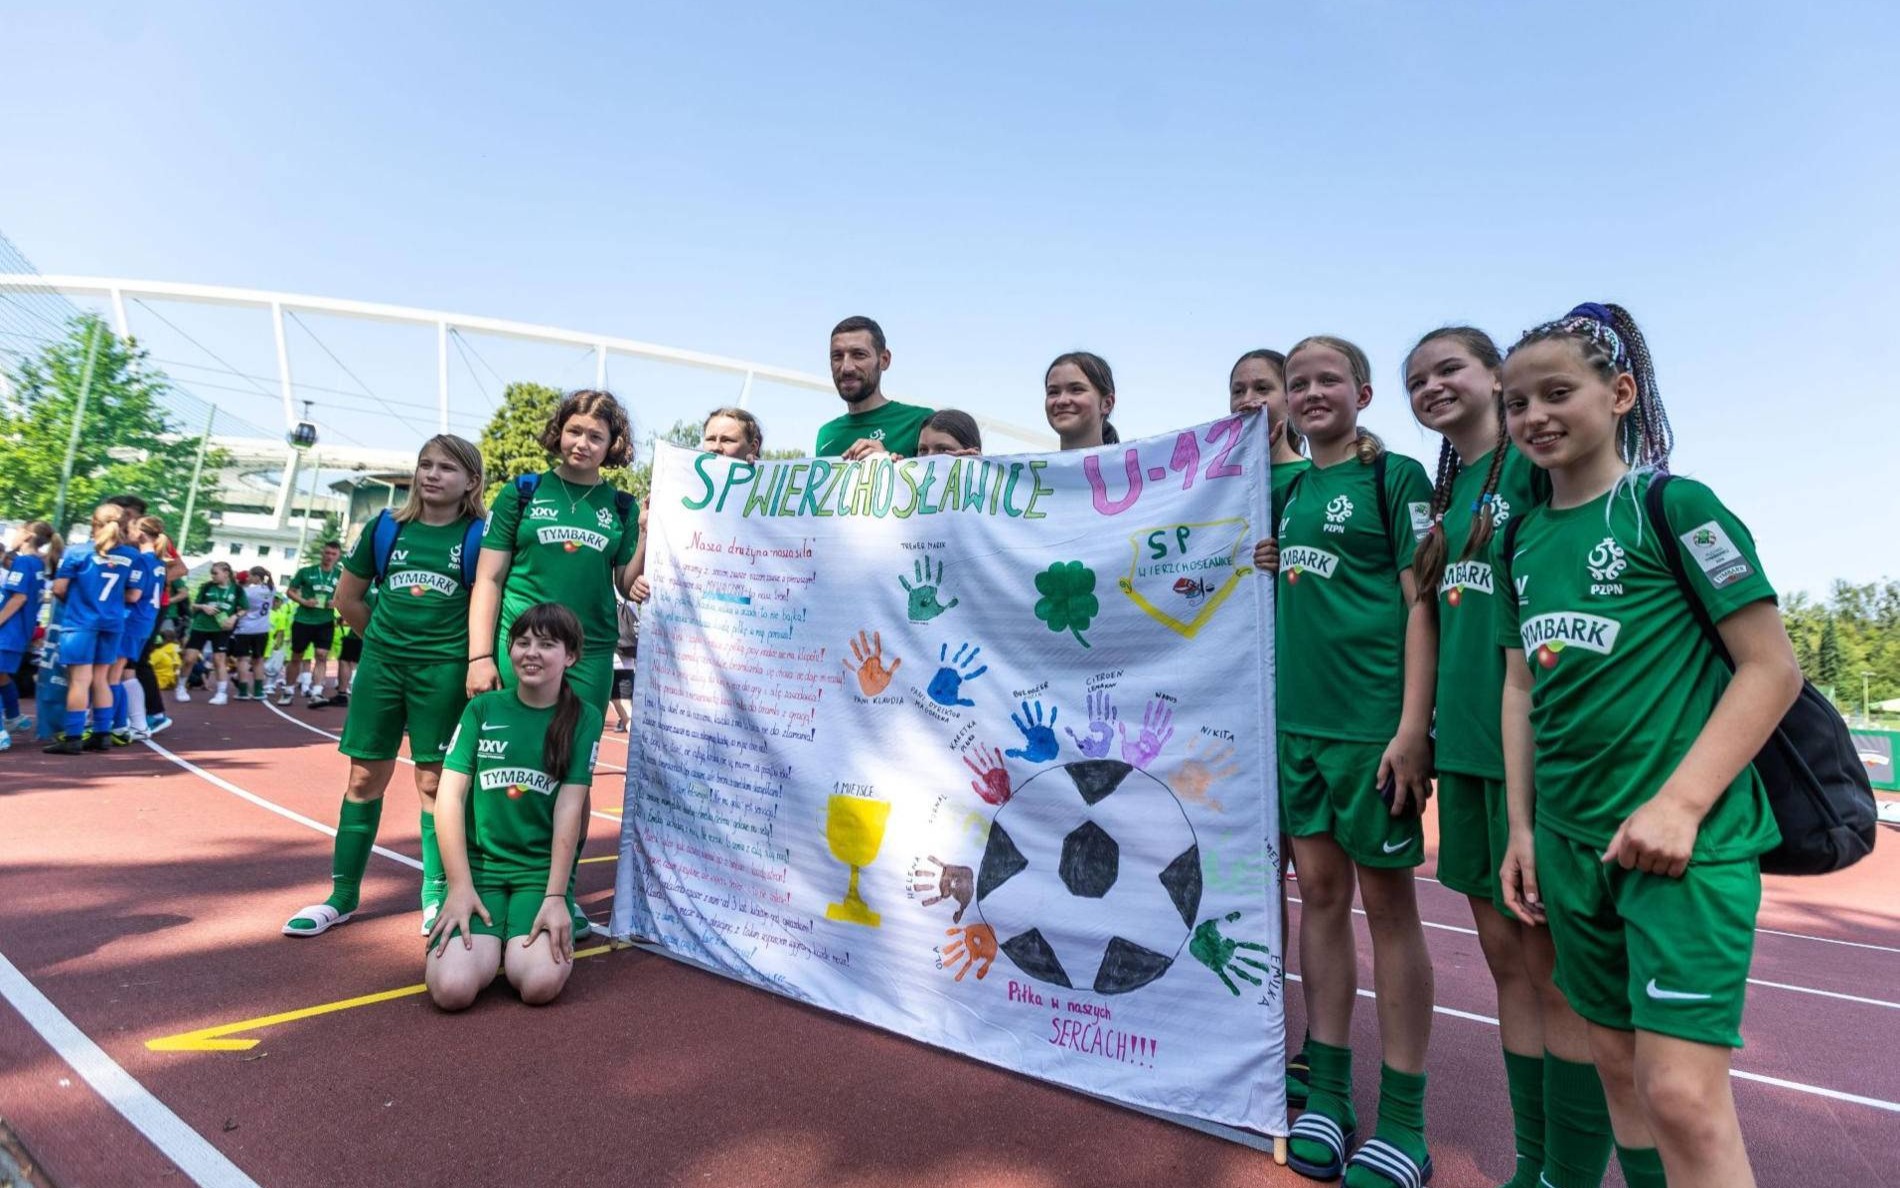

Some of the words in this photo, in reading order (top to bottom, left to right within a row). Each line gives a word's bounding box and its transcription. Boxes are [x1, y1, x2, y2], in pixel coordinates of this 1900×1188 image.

[1083, 416, 1243, 516] U-12
[742, 458, 1054, 519] WIERZCHOSŁAWICE
[530, 507, 559, 518] XXV
[541, 528, 605, 549] TYMBARK
[1323, 523, 1345, 534] PZPN
[1282, 549, 1331, 574] MBARK
[98, 572, 120, 601] 7
[391, 571, 455, 594] TYMBARK
[1441, 564, 1493, 588] MBARK
[1590, 584, 1624, 595] PZPN
[1522, 617, 1609, 648] YMBARK
[1086, 669, 1125, 686] CITROEN
[873, 696, 904, 706] KLAUDIA
[910, 685, 926, 702] PANI
[478, 739, 508, 753] XXV
[1200, 725, 1235, 743] NIKITA
[484, 769, 553, 793] TYMBARK
[905, 856, 921, 900] HELENA
[932, 945, 943, 970] OLA
[1257, 953, 1282, 1008] EMILKA
[1008, 980, 1044, 1006] Piłka
[1051, 998, 1060, 1010] w
[1067, 1001, 1112, 1026] naszych
[1048, 1017, 1158, 1069] SERCACH!!!
